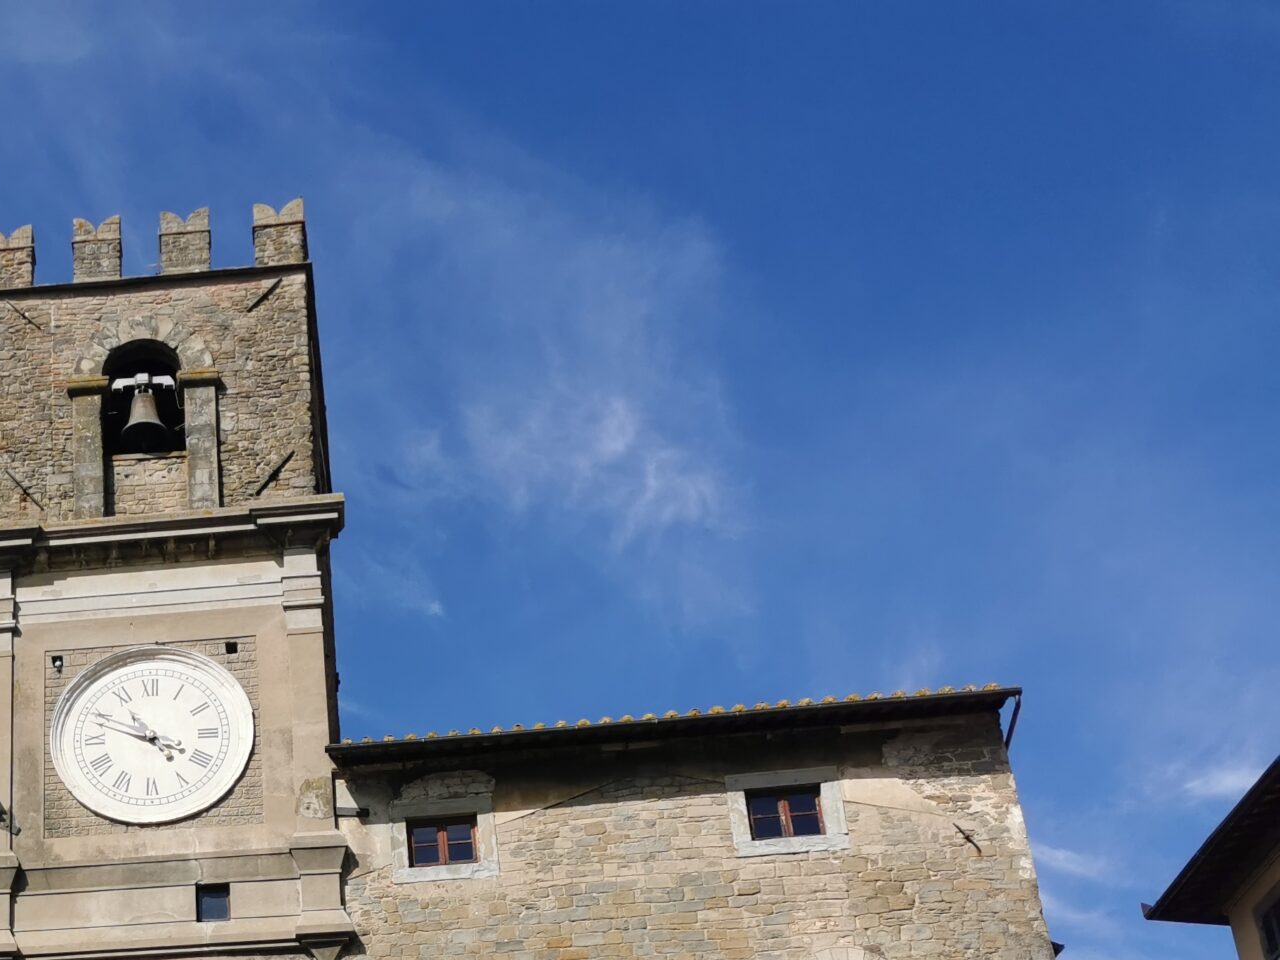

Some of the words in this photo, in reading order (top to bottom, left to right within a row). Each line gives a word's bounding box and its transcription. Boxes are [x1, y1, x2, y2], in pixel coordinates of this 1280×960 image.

[112, 686, 133, 706] XI
[141, 679, 159, 697] XII
[190, 701, 210, 717] II
[198, 727, 219, 739] III
